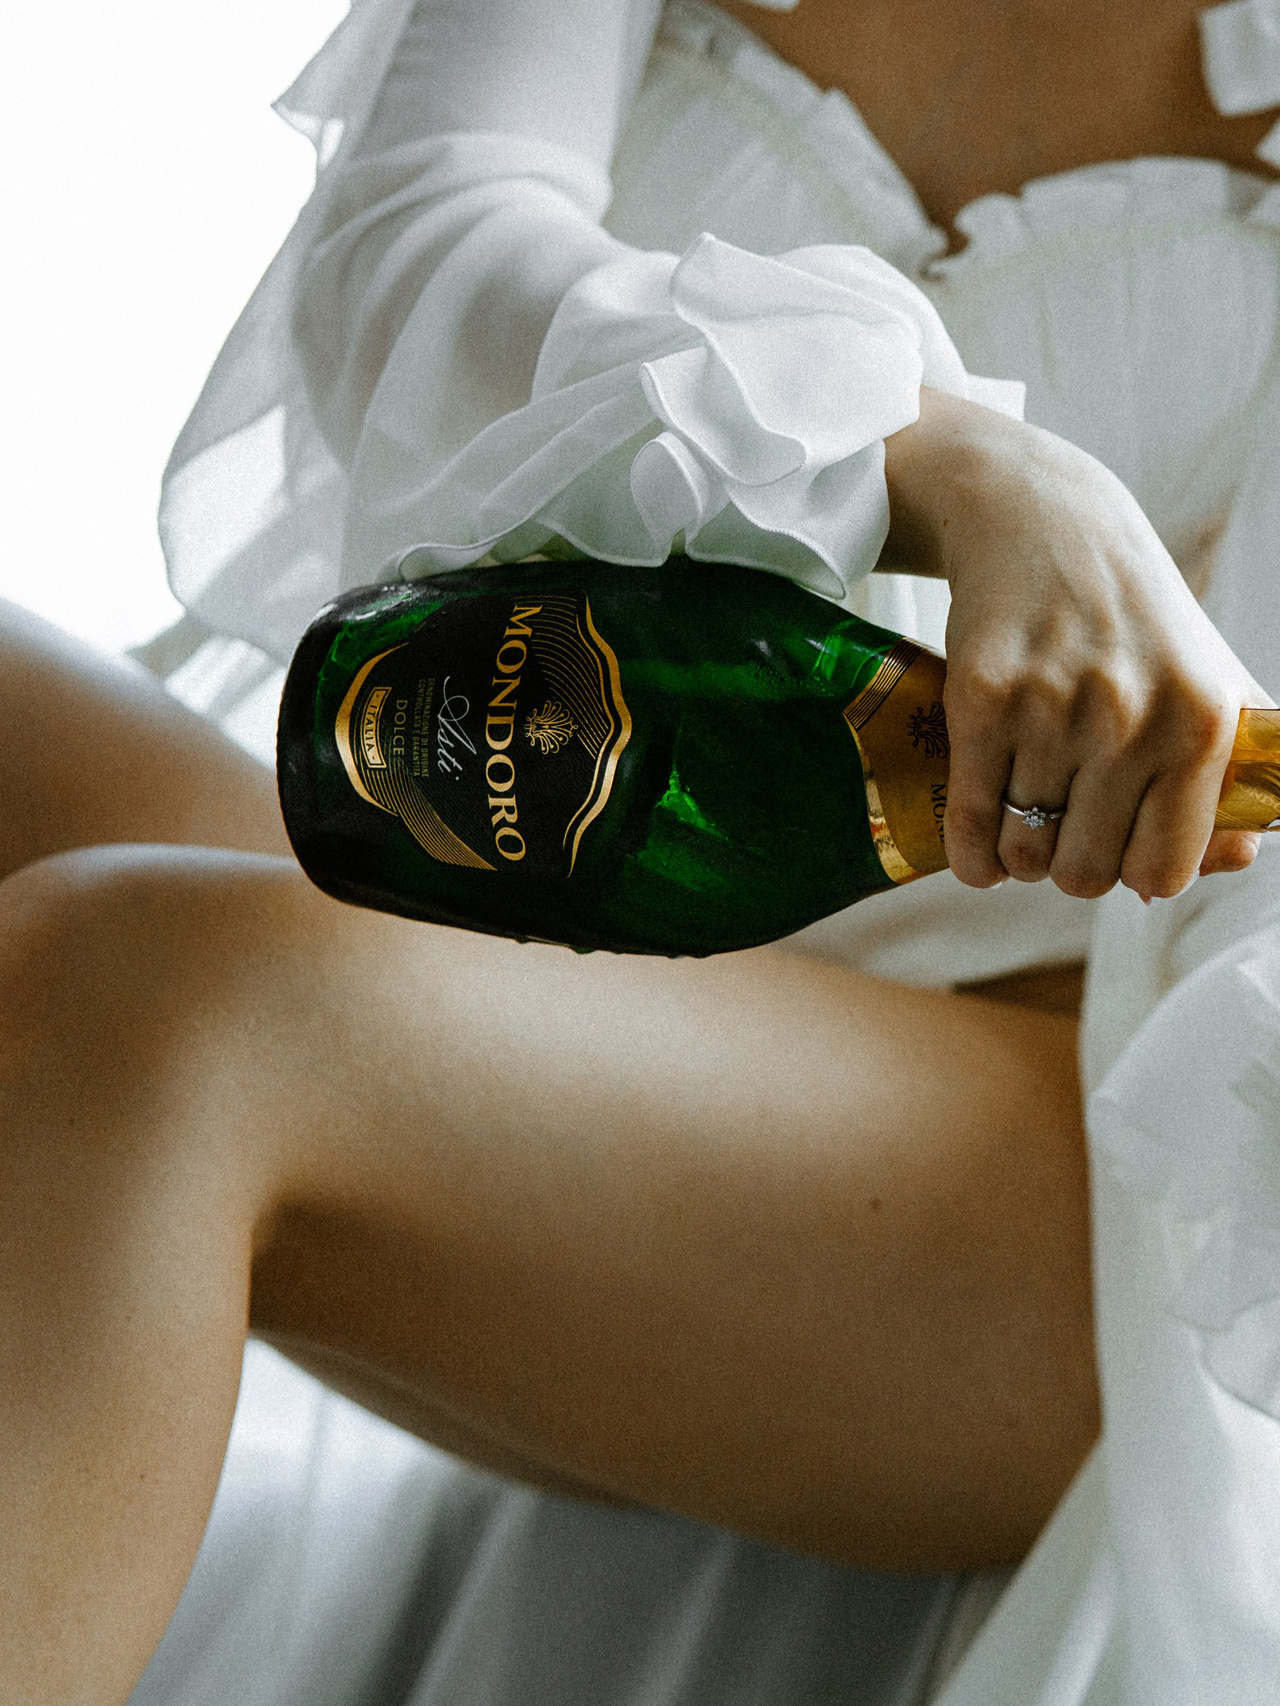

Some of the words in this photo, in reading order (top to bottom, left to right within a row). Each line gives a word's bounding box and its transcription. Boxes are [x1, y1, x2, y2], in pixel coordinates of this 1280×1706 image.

[365, 704, 378, 752] ITALIA
[393, 699, 408, 756] DOLCE
[413, 679, 426, 728] CONTROLLATA
[421, 677, 435, 735] DENOMINAZIONE
[437, 675, 477, 781] Asti
[421, 738, 429, 746] DI
[485, 604, 543, 862] MONDORO
[421, 748, 430, 778] ORIGINE
